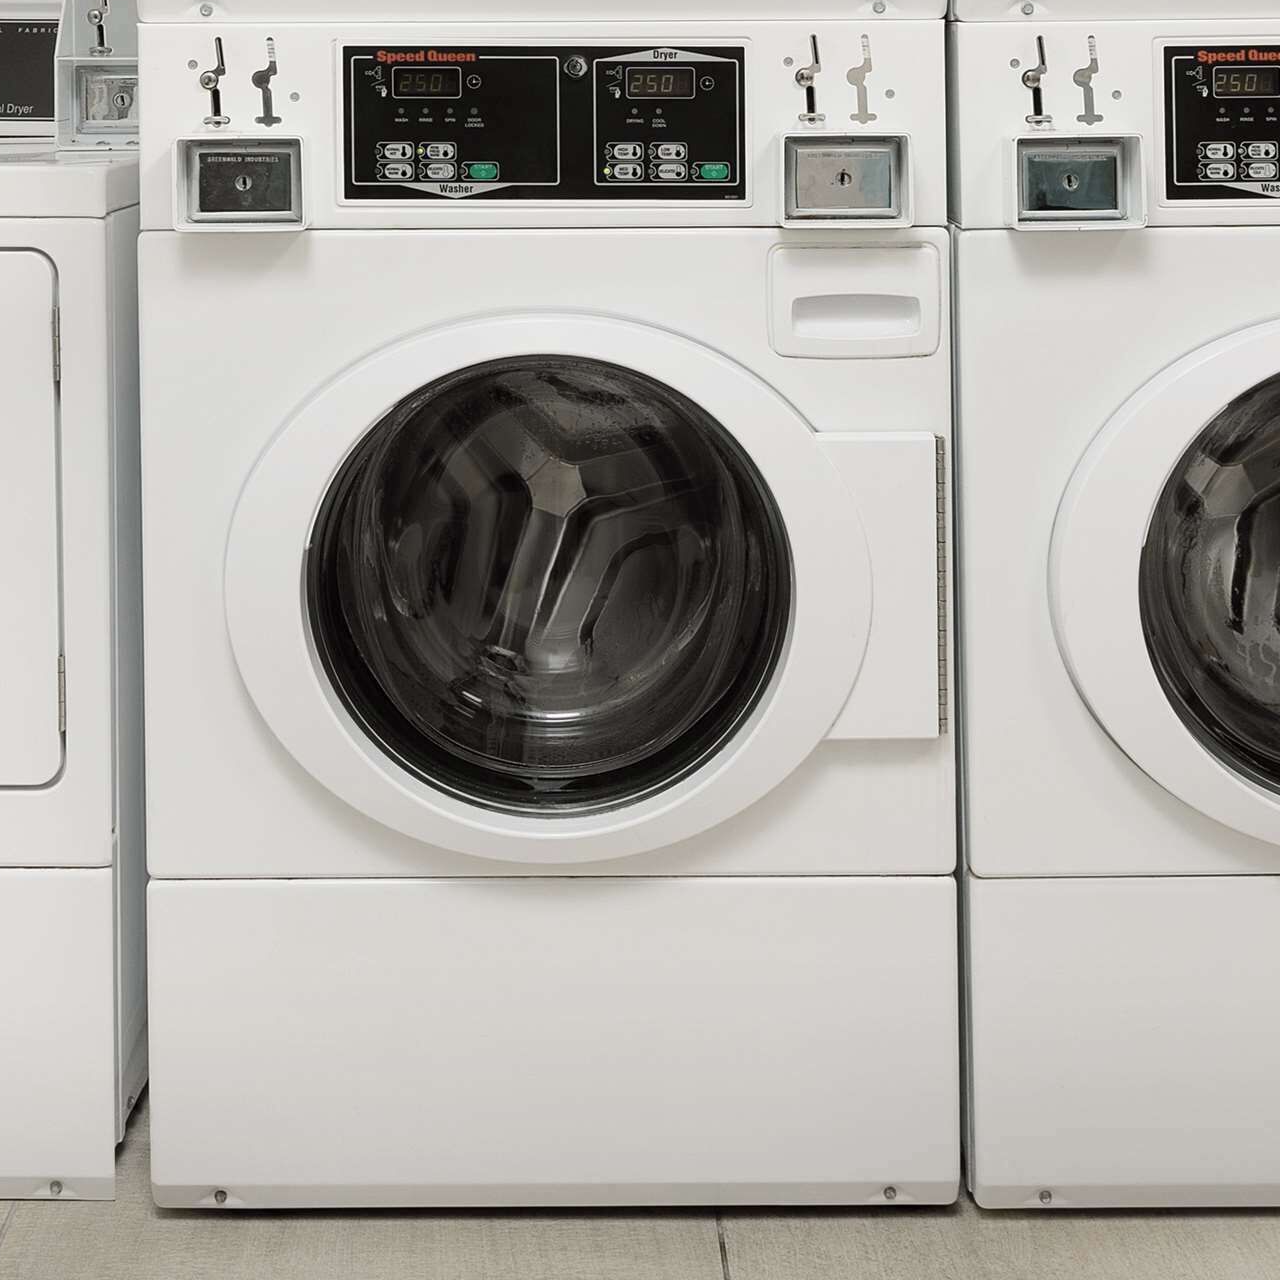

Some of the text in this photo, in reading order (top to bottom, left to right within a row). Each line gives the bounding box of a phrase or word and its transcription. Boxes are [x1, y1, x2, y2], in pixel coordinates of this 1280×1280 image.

[376, 50, 476, 64] Speed Queen
[653, 50, 678, 61] Dryer
[1197, 50, 1246, 64] Speed
[399, 74, 442, 92] 250
[630, 74, 673, 93] 250
[1215, 74, 1257, 92] 250
[7, 103, 34, 116] Dryer
[439, 184, 474, 194] Washer
